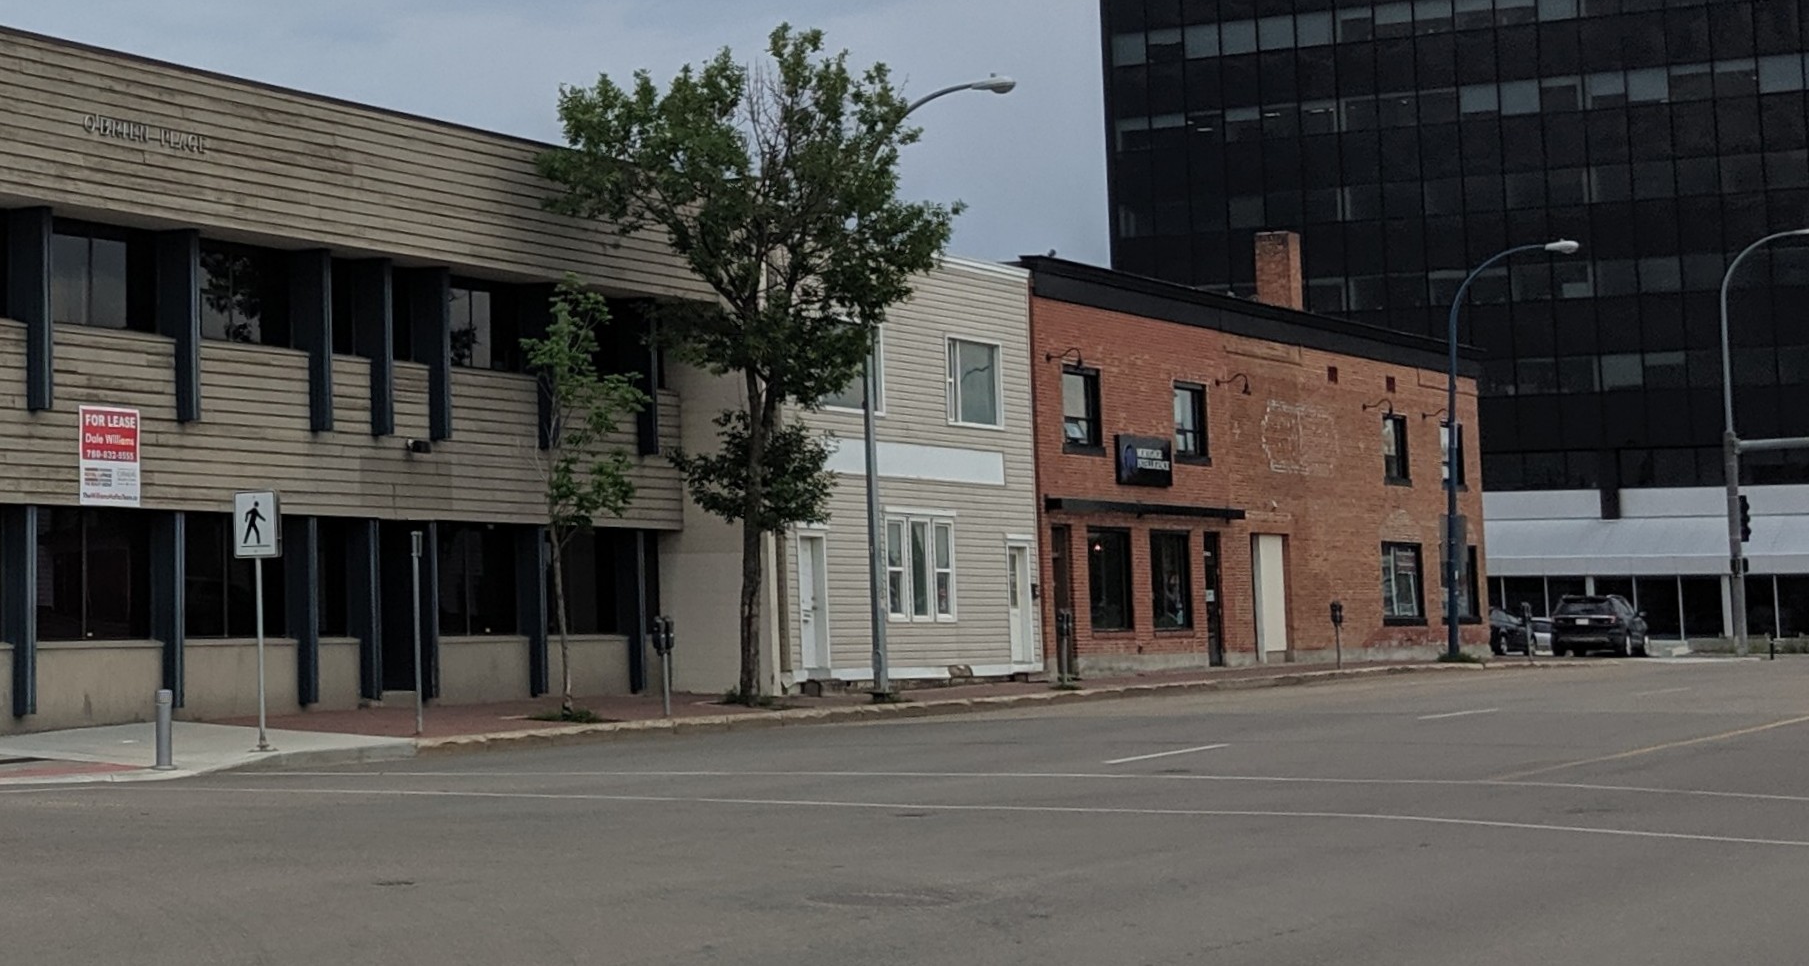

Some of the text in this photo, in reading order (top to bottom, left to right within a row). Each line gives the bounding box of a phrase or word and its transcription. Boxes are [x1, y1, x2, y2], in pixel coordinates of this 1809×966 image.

[160, 128, 207, 154] PLACE
[85, 414, 136, 429] FOR LEASE
[85, 433, 135, 446] Dale Williams
